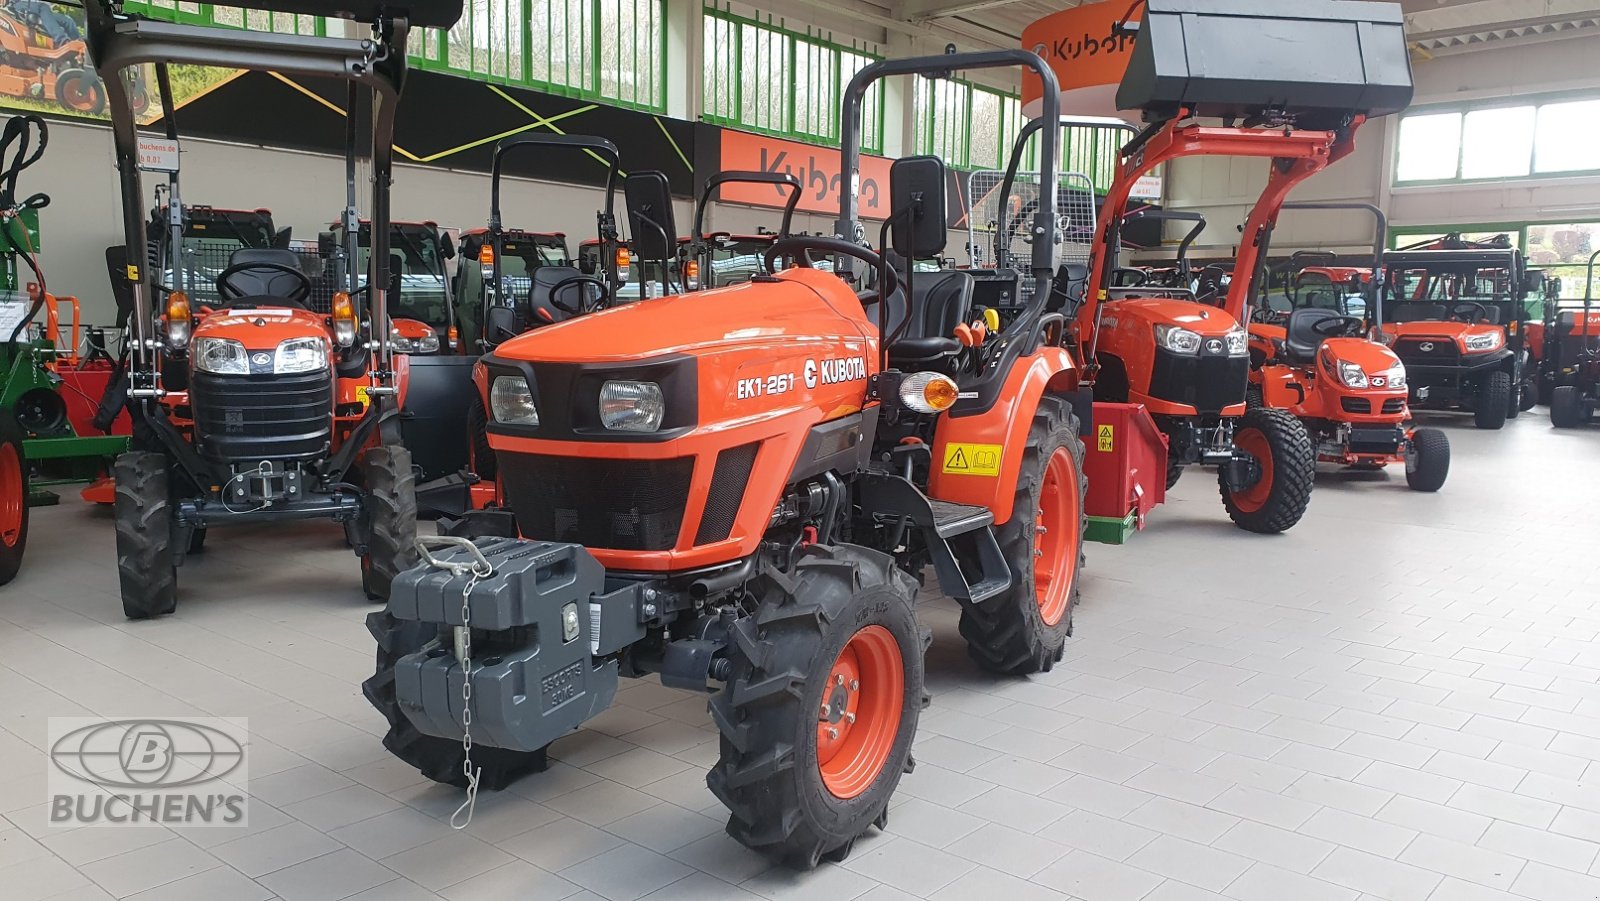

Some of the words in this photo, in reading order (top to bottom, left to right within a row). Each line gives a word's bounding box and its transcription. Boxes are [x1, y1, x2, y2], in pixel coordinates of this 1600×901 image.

[760, 147, 879, 208] Kuboa
[736, 372, 795, 400] EK1-261
[820, 356, 867, 385] KUBOTA
